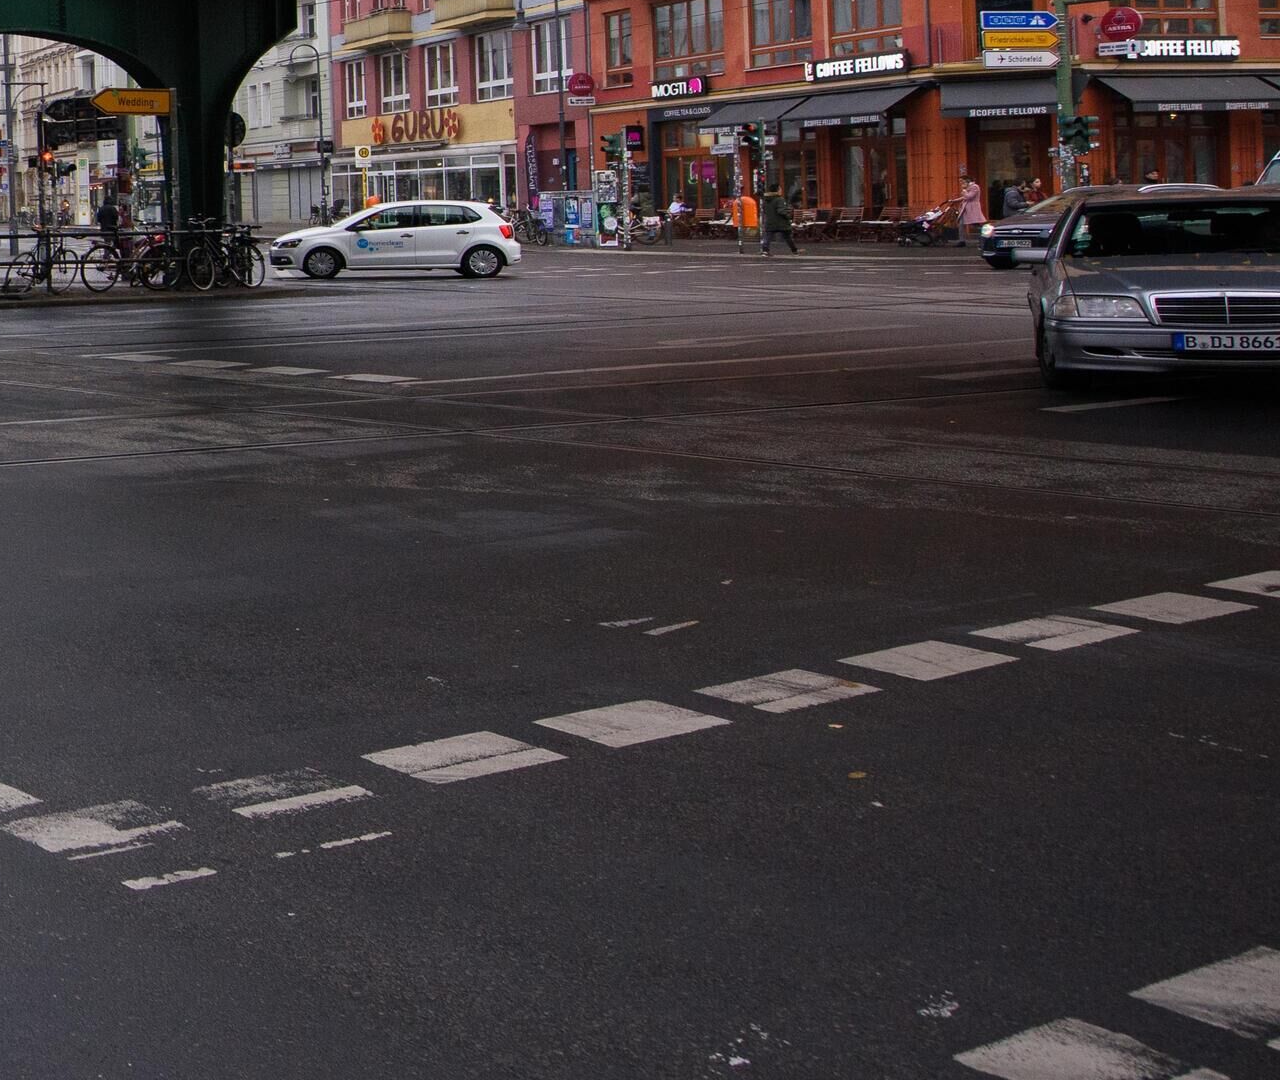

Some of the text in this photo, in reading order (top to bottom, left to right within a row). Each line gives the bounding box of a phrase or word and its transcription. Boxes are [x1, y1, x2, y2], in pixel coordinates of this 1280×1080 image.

[1186, 40, 1240, 56] FELLOWS
[816, 53, 904, 78] COFFEE FELLOWS
[1008, 55, 1042, 63] Schönefeld
[118, 97, 154, 109] Wedding
[976, 106, 1047, 117] COFFEE FELLOWS
[391, 108, 444, 143] GURU
[1185, 335, 1198, 349] B
[1210, 335, 1234, 349] DJ
